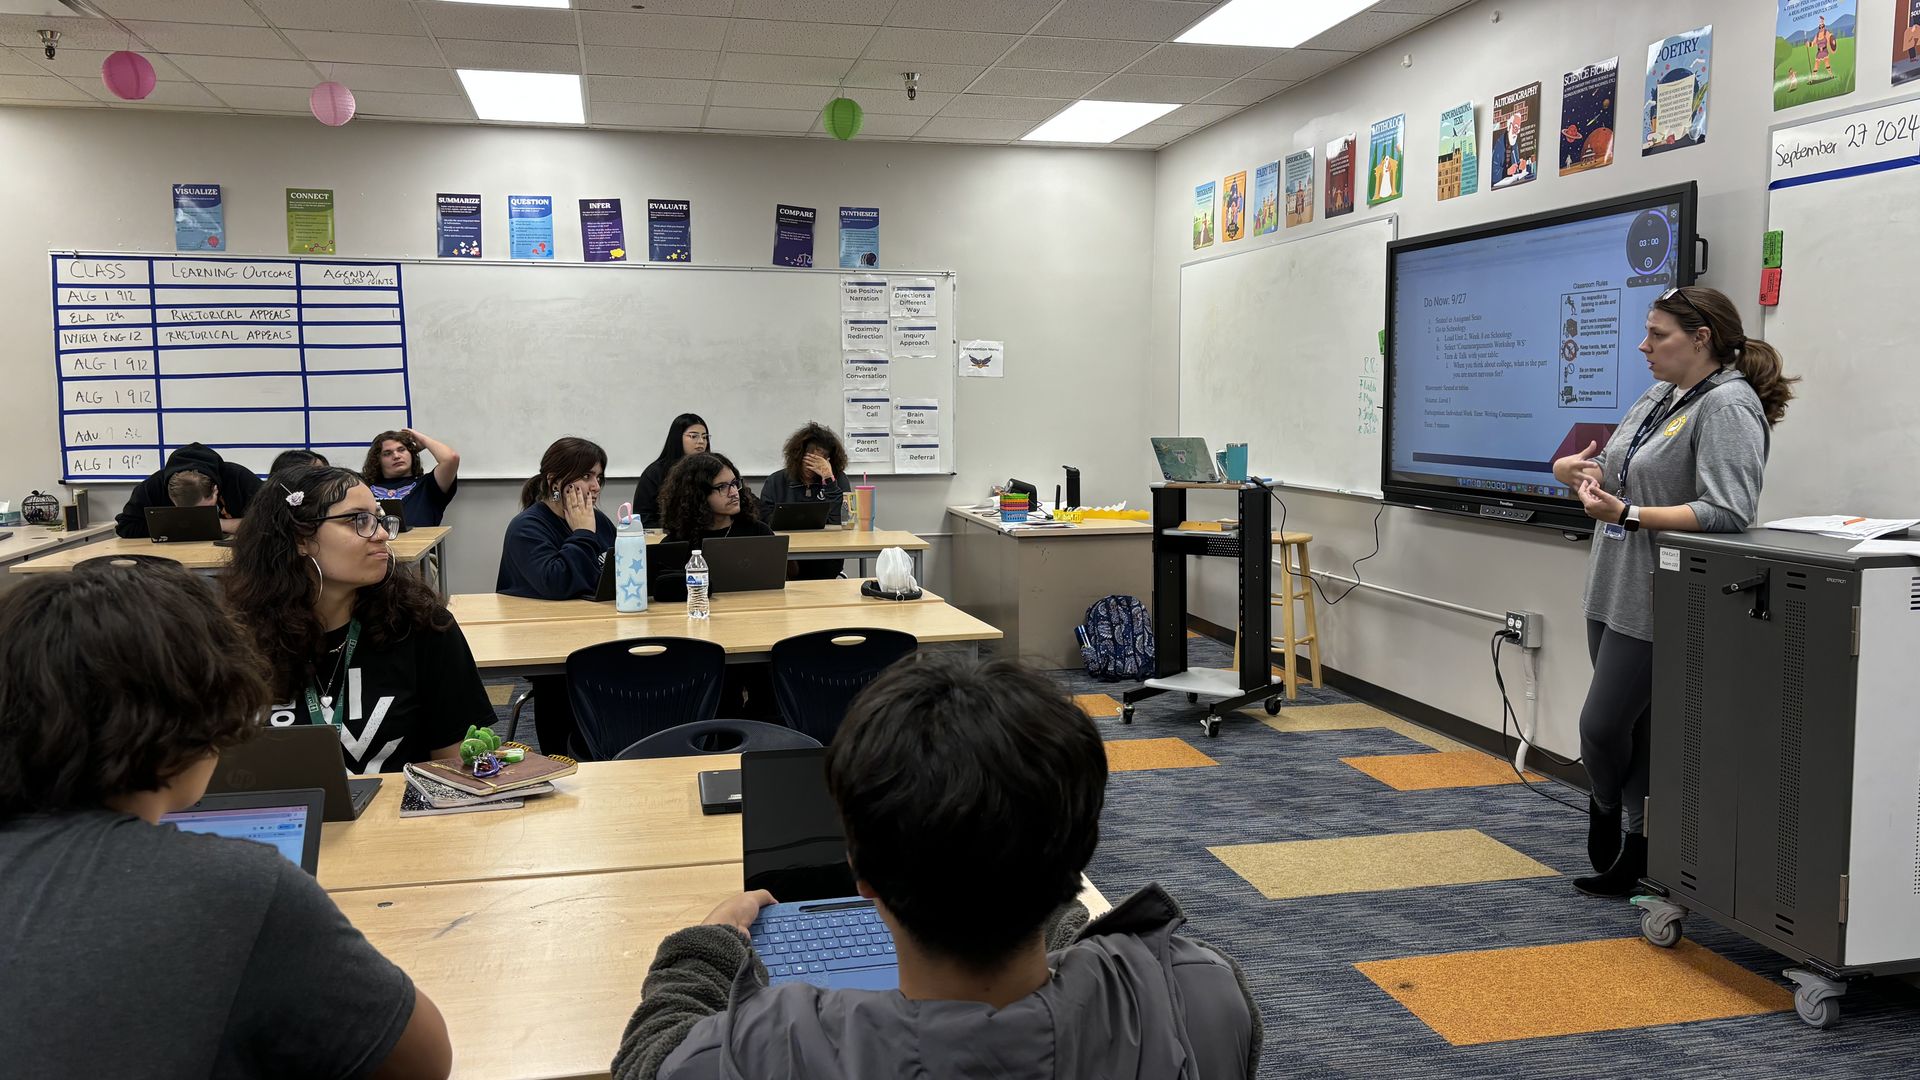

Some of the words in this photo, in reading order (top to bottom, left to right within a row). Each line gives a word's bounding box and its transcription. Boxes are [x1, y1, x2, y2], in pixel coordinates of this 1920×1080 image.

[1655, 37, 1700, 63] POETRY
[1564, 68, 1589, 86] SCIENCE
[1590, 60, 1617, 77] FICTION
[1494, 84, 1538, 108] AUTOBIOGRAPHY
[1775, 140, 1837, 168] September
[1845, 124, 1868, 148] 27
[1875, 114, 1920, 146] 2024
[649, 202, 688, 210] EVALUATE
[779, 208, 814, 218] COMPARE
[70, 260, 126, 279] CLASS
[171, 262, 238, 279] LEARNING
[242, 265, 294, 279] OUTCOME
[67, 290, 97, 302] ALG
[105, 291, 108, 301] 1
[1424, 297, 1432, 307] Do
[1434, 296, 1450, 306] Now:
[1452, 293, 1467, 305] 9/27
[70, 312, 94, 323] ELA
[171, 309, 242, 321] RHETORICAL
[249, 309, 291, 320] APPEALS
[104, 332, 125, 342] ENG
[130, 331, 142, 341] 12
[166, 329, 239, 342] RHETORICAL
[247, 330, 292, 341] APPEALS
[74, 358, 106, 370] ALG
[114, 359, 117, 370] 1
[75, 391, 103, 404] ALG
[115, 390, 119, 403] 1
[74, 459, 101, 472] ALG
[109, 458, 111, 469] 1
